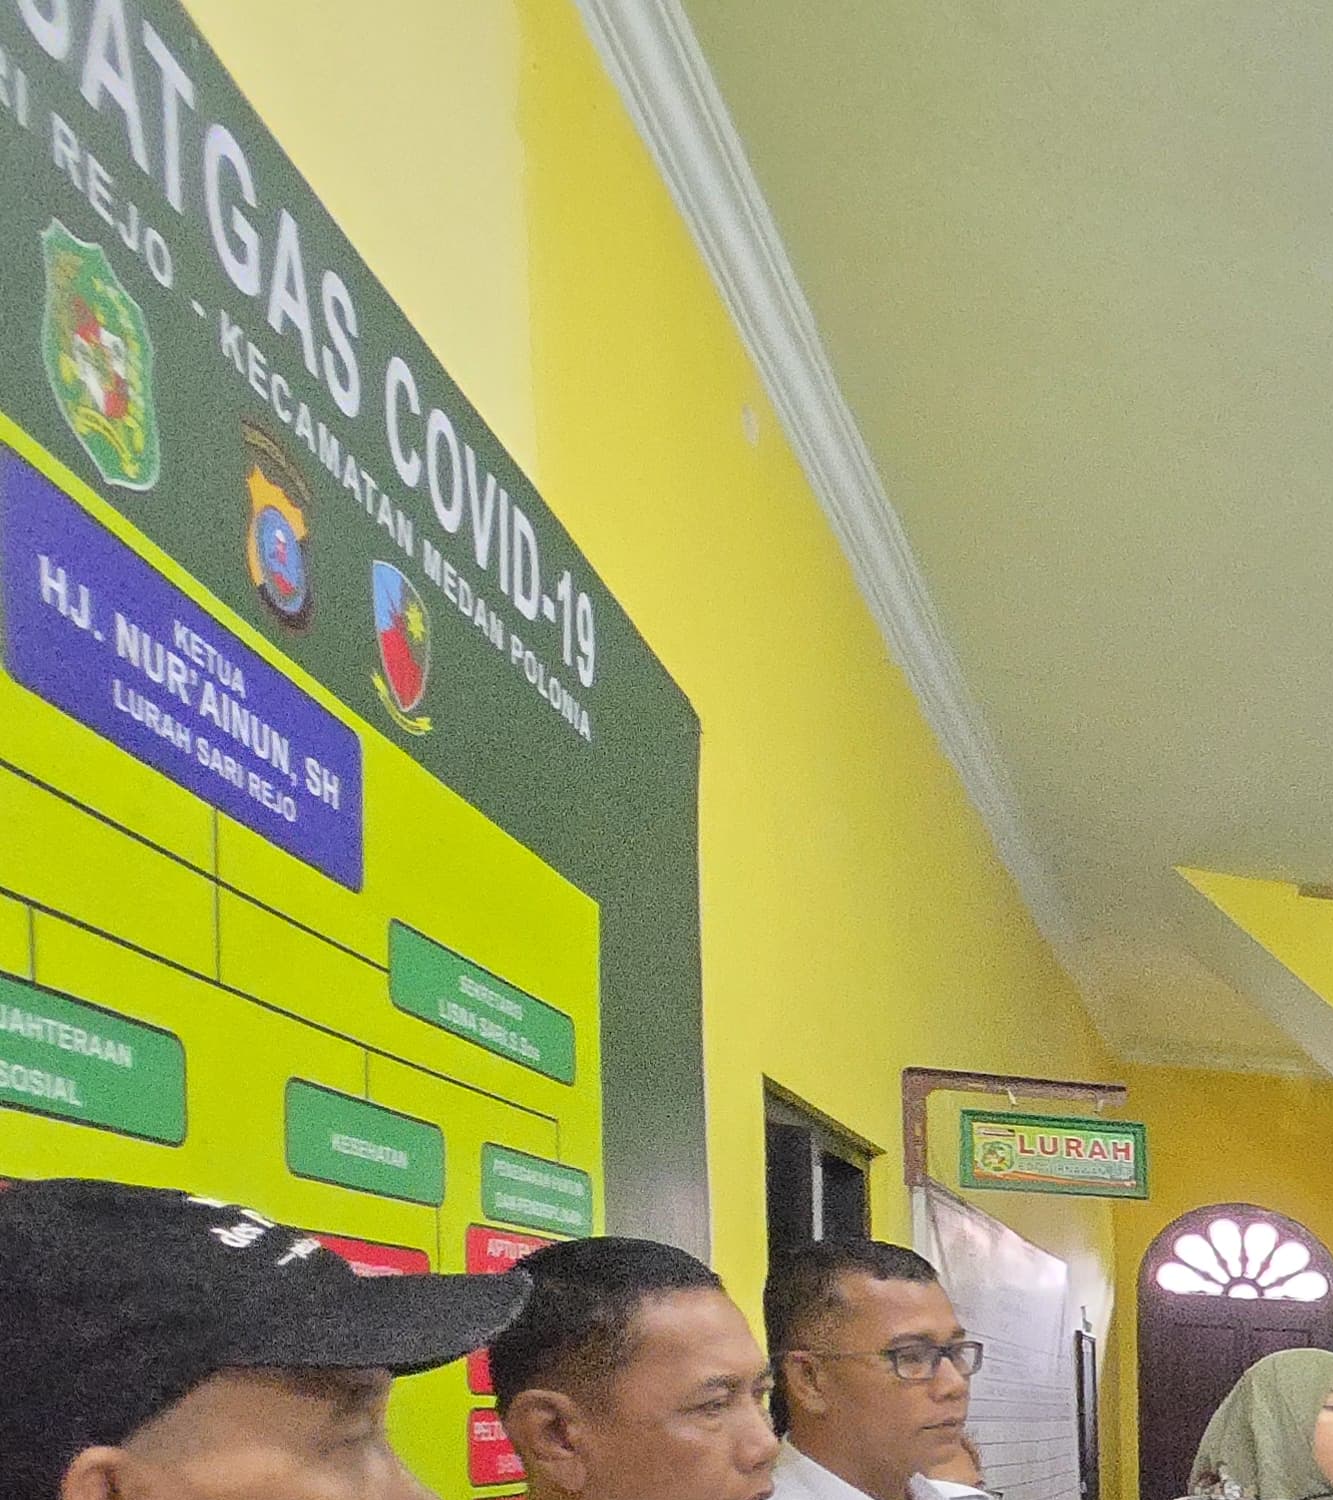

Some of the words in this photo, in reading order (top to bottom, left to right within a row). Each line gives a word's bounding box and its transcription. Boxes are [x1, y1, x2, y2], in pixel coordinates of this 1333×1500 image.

[50, 110, 174, 290] REJO
[219, 308, 415, 556] KECAMATAN
[423, 539, 505, 651] MEDAN
[510, 634, 592, 741] POLONIA
[386, 357, 597, 688] COVID-19
[37, 553, 106, 642] HJ.
[304, 755, 341, 811] SH
[112, 678, 194, 755] LURAH
[196, 736, 248, 788] SARI
[247, 771, 298, 823] REJO
[173, 618, 247, 699] KETUA
[1017, 1133, 1133, 1163] LURAH
